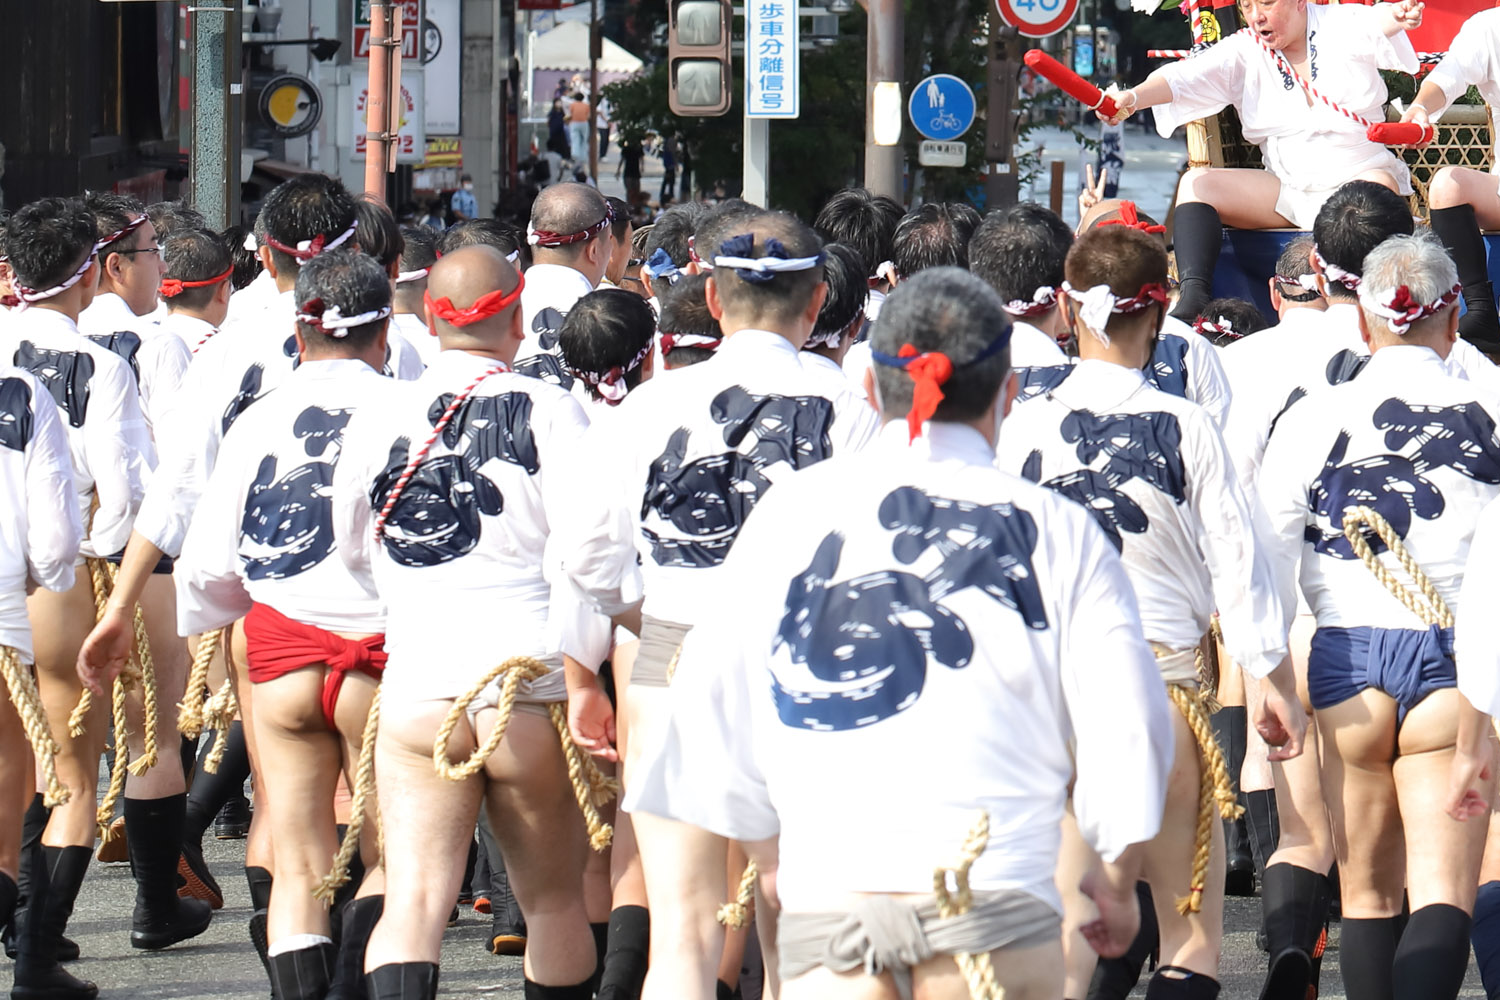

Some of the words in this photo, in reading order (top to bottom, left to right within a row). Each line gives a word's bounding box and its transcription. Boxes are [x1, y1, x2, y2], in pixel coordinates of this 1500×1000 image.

[758, 3, 784, 109] 歩車分離信号
